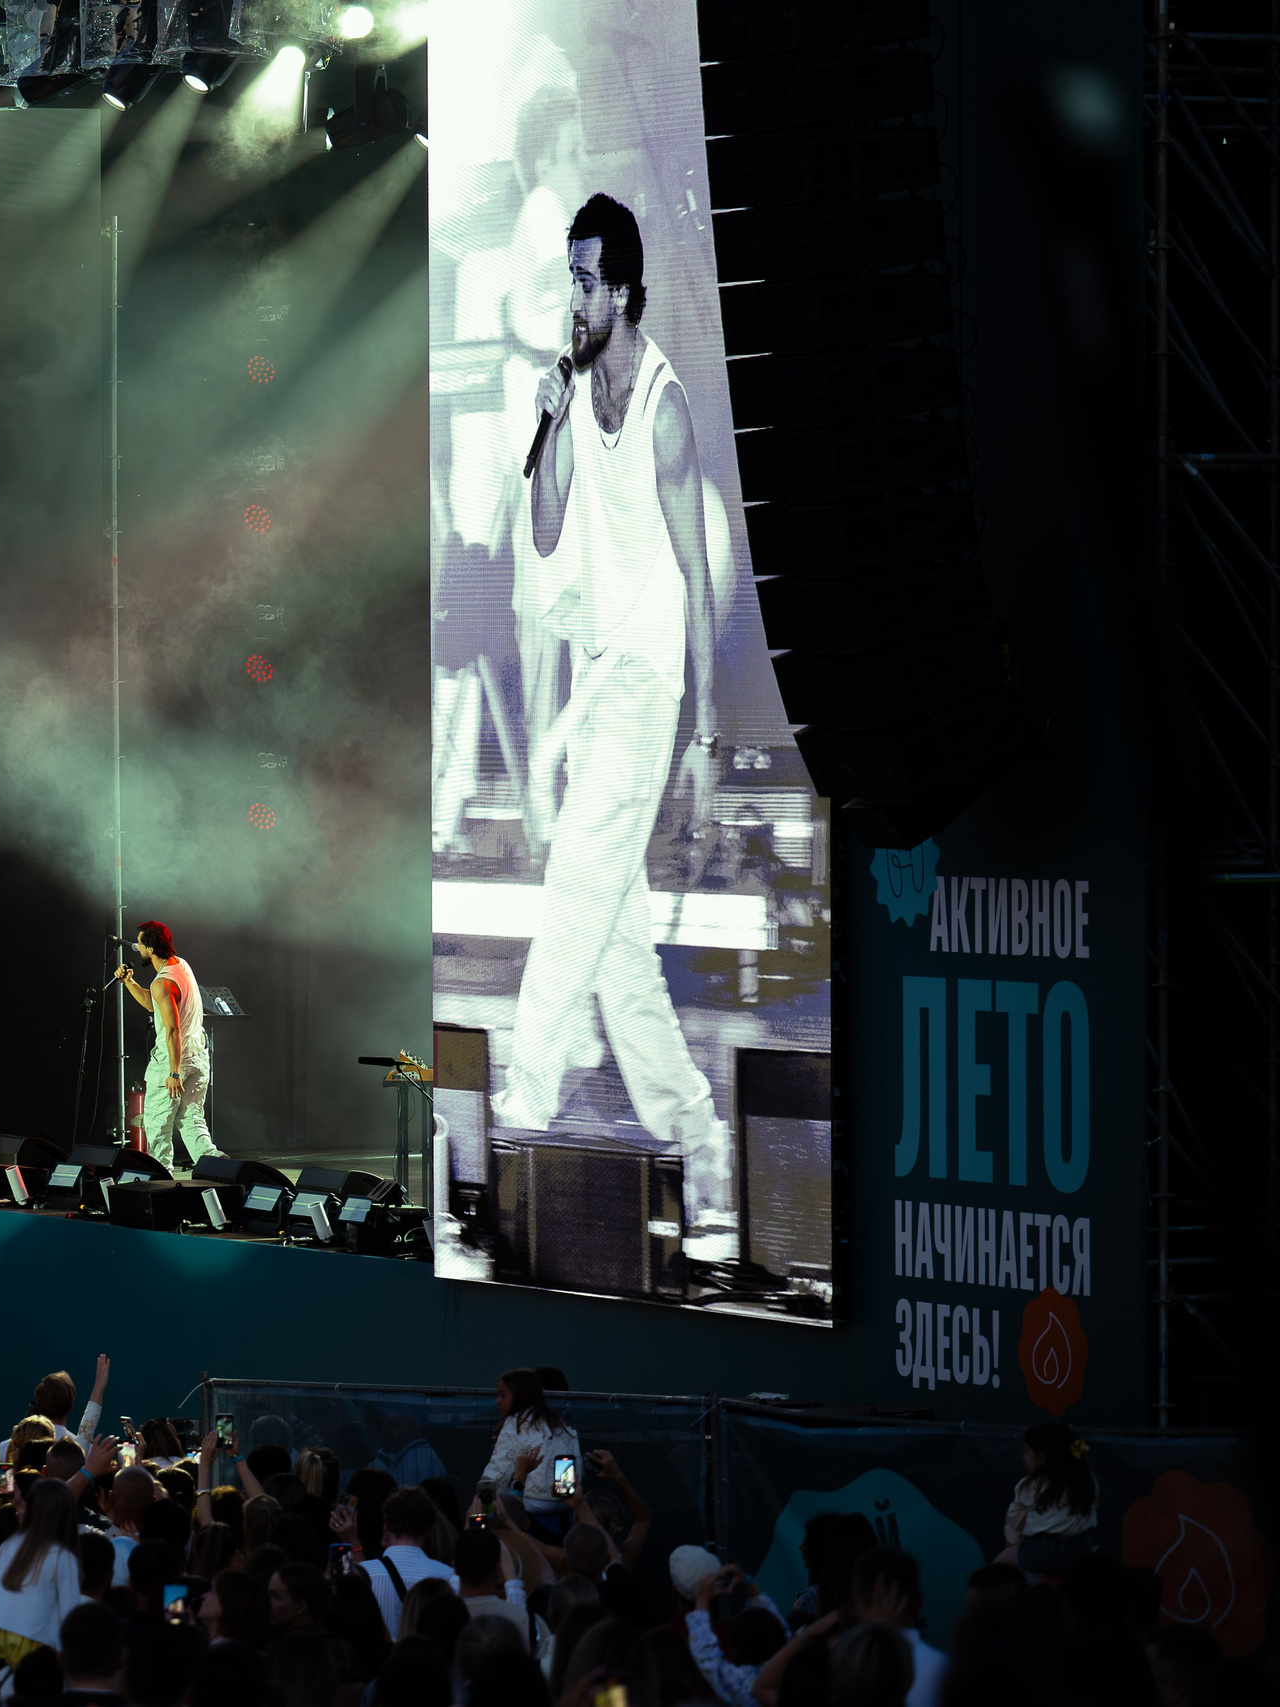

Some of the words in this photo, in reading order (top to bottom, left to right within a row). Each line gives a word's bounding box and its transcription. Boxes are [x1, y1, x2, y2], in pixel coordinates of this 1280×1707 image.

[929, 875, 1090, 960] АКТИВНОЕ
[894, 975, 1090, 1194] ЛЕТО
[894, 1200, 1091, 1297] НАЧИНАЕТСЯ
[894, 1298, 1000, 1391] ЗДЕСЬ!
